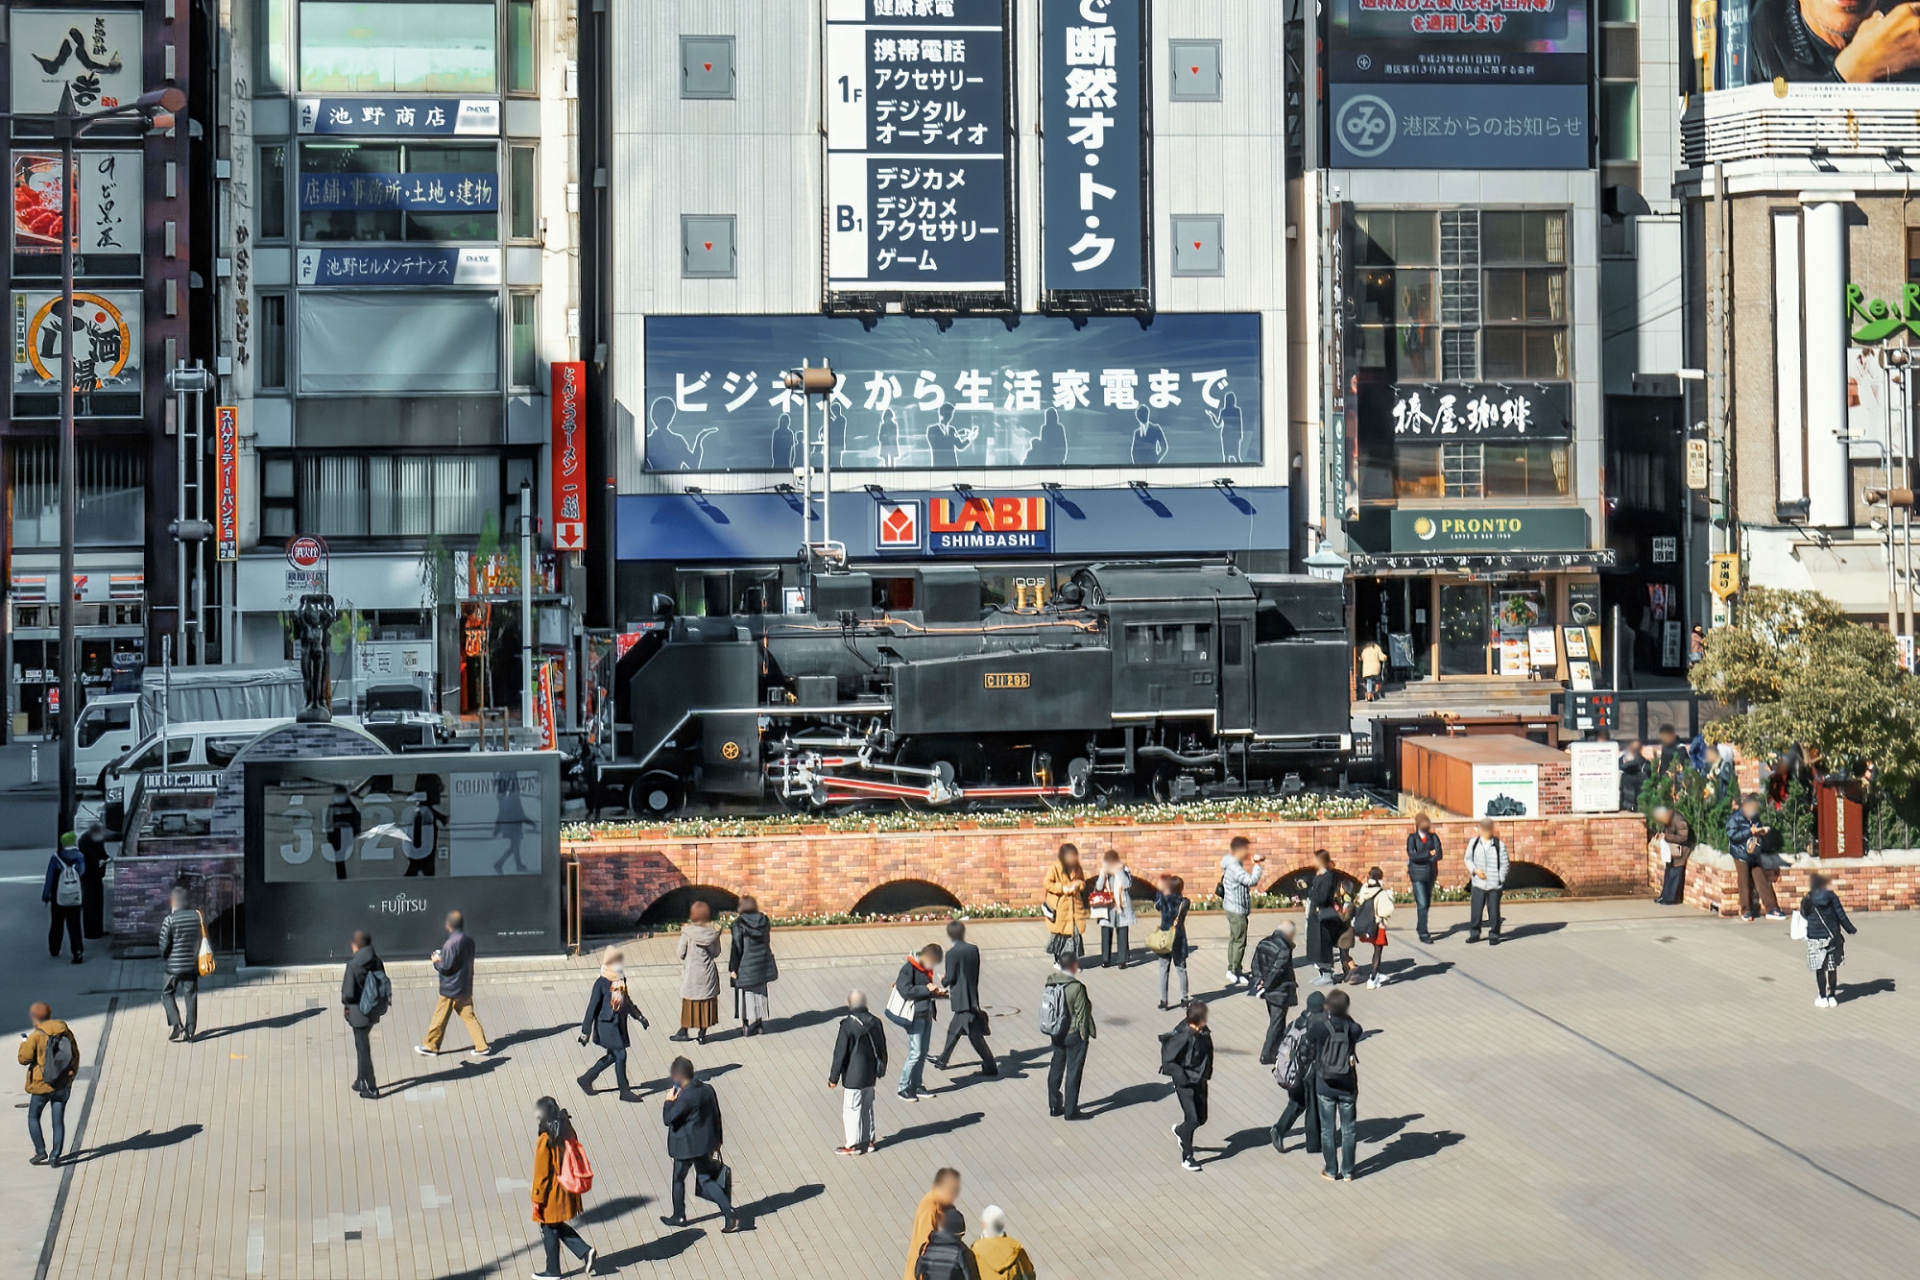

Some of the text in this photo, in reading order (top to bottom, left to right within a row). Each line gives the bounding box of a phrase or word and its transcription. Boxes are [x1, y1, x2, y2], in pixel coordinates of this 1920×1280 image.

[1412, 13, 1506, 32] を適用します
[874, 39, 966, 63] 携帯電話
[837, 75, 863, 103] 1F
[874, 68, 984, 91] アクセサリー
[329, 106, 447, 127] 池野商店
[875, 99, 967, 122] デジタル
[875, 123, 988, 146] オーディオ
[1403, 116, 1582, 137] 港区からのお知らせ
[876, 168, 967, 191] デジカメ
[837, 205, 863, 233] B1
[876, 197, 958, 219] デジカメ
[876, 220, 1000, 242] アクセサリー
[326, 257, 450, 276] 池野ビルメンテナンス
[876, 248, 939, 272] ゲーム
[675, 369, 1229, 412] ビジネスから生活家電まで
[562, 366, 578, 476] とんこつラーメン
[561, 484, 579, 519] 一蘭
[930, 497, 1045, 532] LABI
[1441, 518, 1522, 532] PRONTO
[295, 546, 318, 558] 消火栓
[942, 534, 1036, 547] SHIMBASHI
[455, 777, 537, 796] COUNTDOWN
[382, 894, 427, 914] FUJITSU
